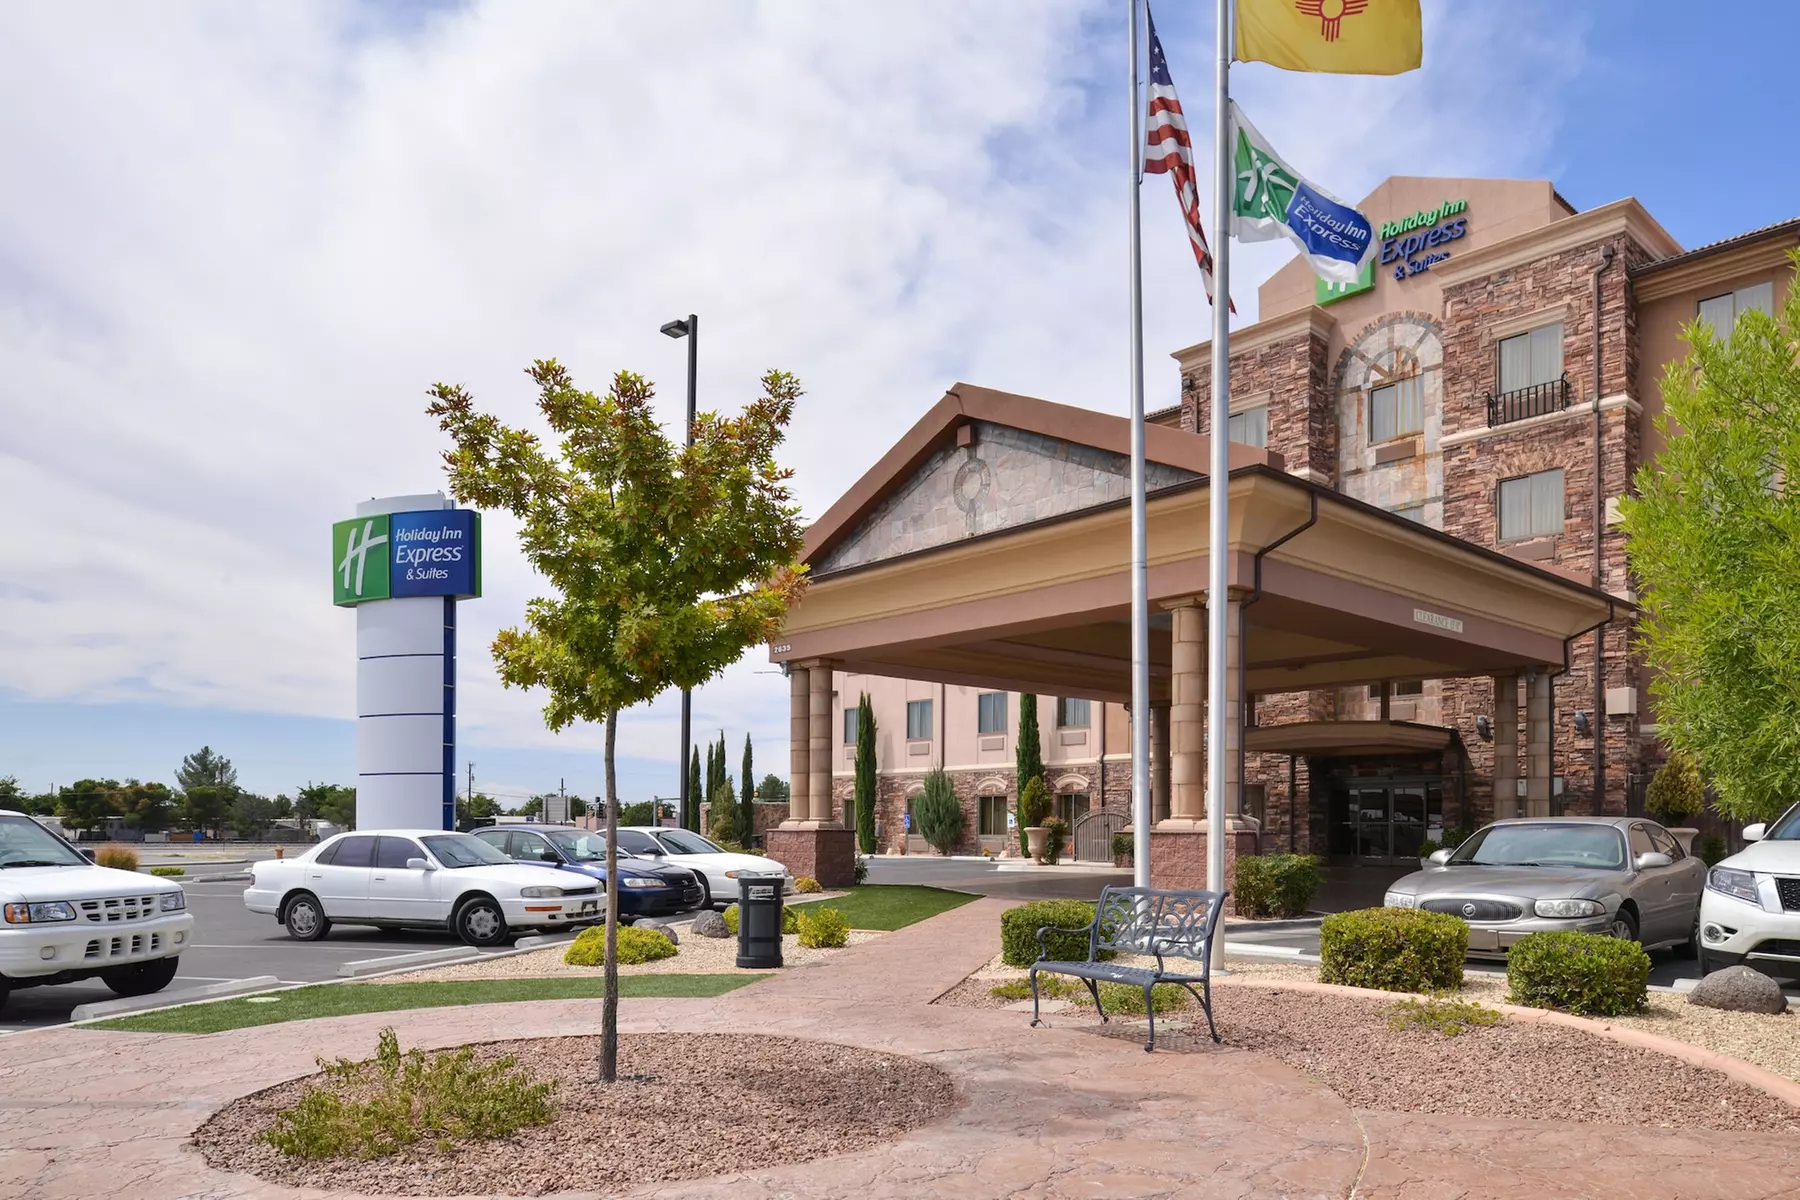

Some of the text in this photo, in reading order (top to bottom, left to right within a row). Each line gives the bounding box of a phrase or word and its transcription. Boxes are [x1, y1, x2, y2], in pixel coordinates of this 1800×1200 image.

[1294, 204, 1361, 251] Express
[1301, 196, 1367, 240] Holiday Inn
[1379, 200, 1467, 240] Holiday Inn
[1380, 218, 1467, 265] Express
[1393, 264, 1406, 280] &
[396, 526, 462, 543] Holiday Inn
[395, 545, 463, 567] Express
[406, 567, 449, 580] & Suites
